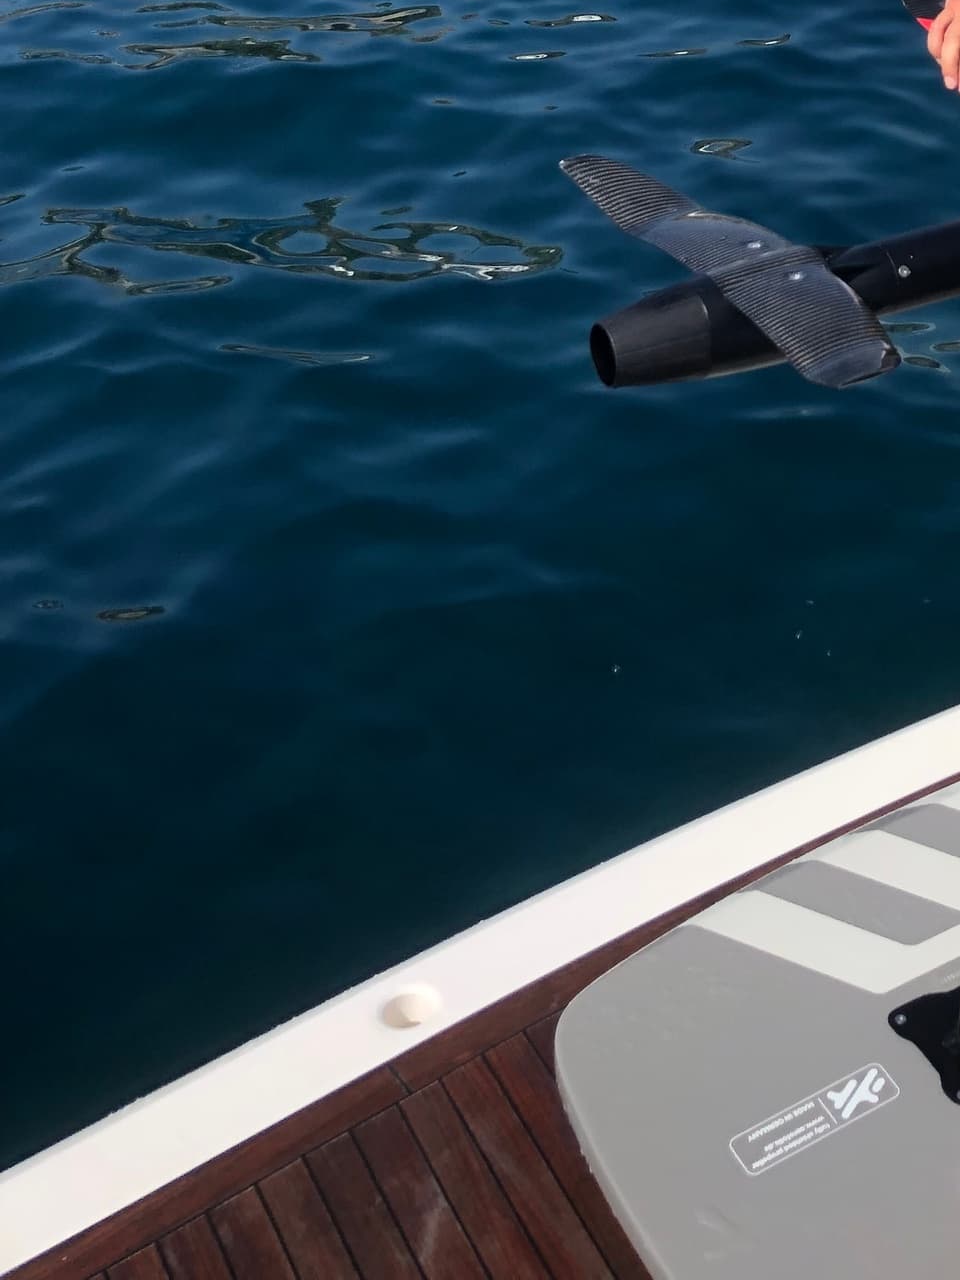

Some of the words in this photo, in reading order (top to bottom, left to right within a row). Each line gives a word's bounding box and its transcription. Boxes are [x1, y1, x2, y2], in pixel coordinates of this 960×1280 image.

[783, 1112, 793, 1121] IN
[793, 1101, 815, 1117] MADE
[747, 1118, 784, 1142] GERMANY
[751, 1147, 783, 1169] propeller
